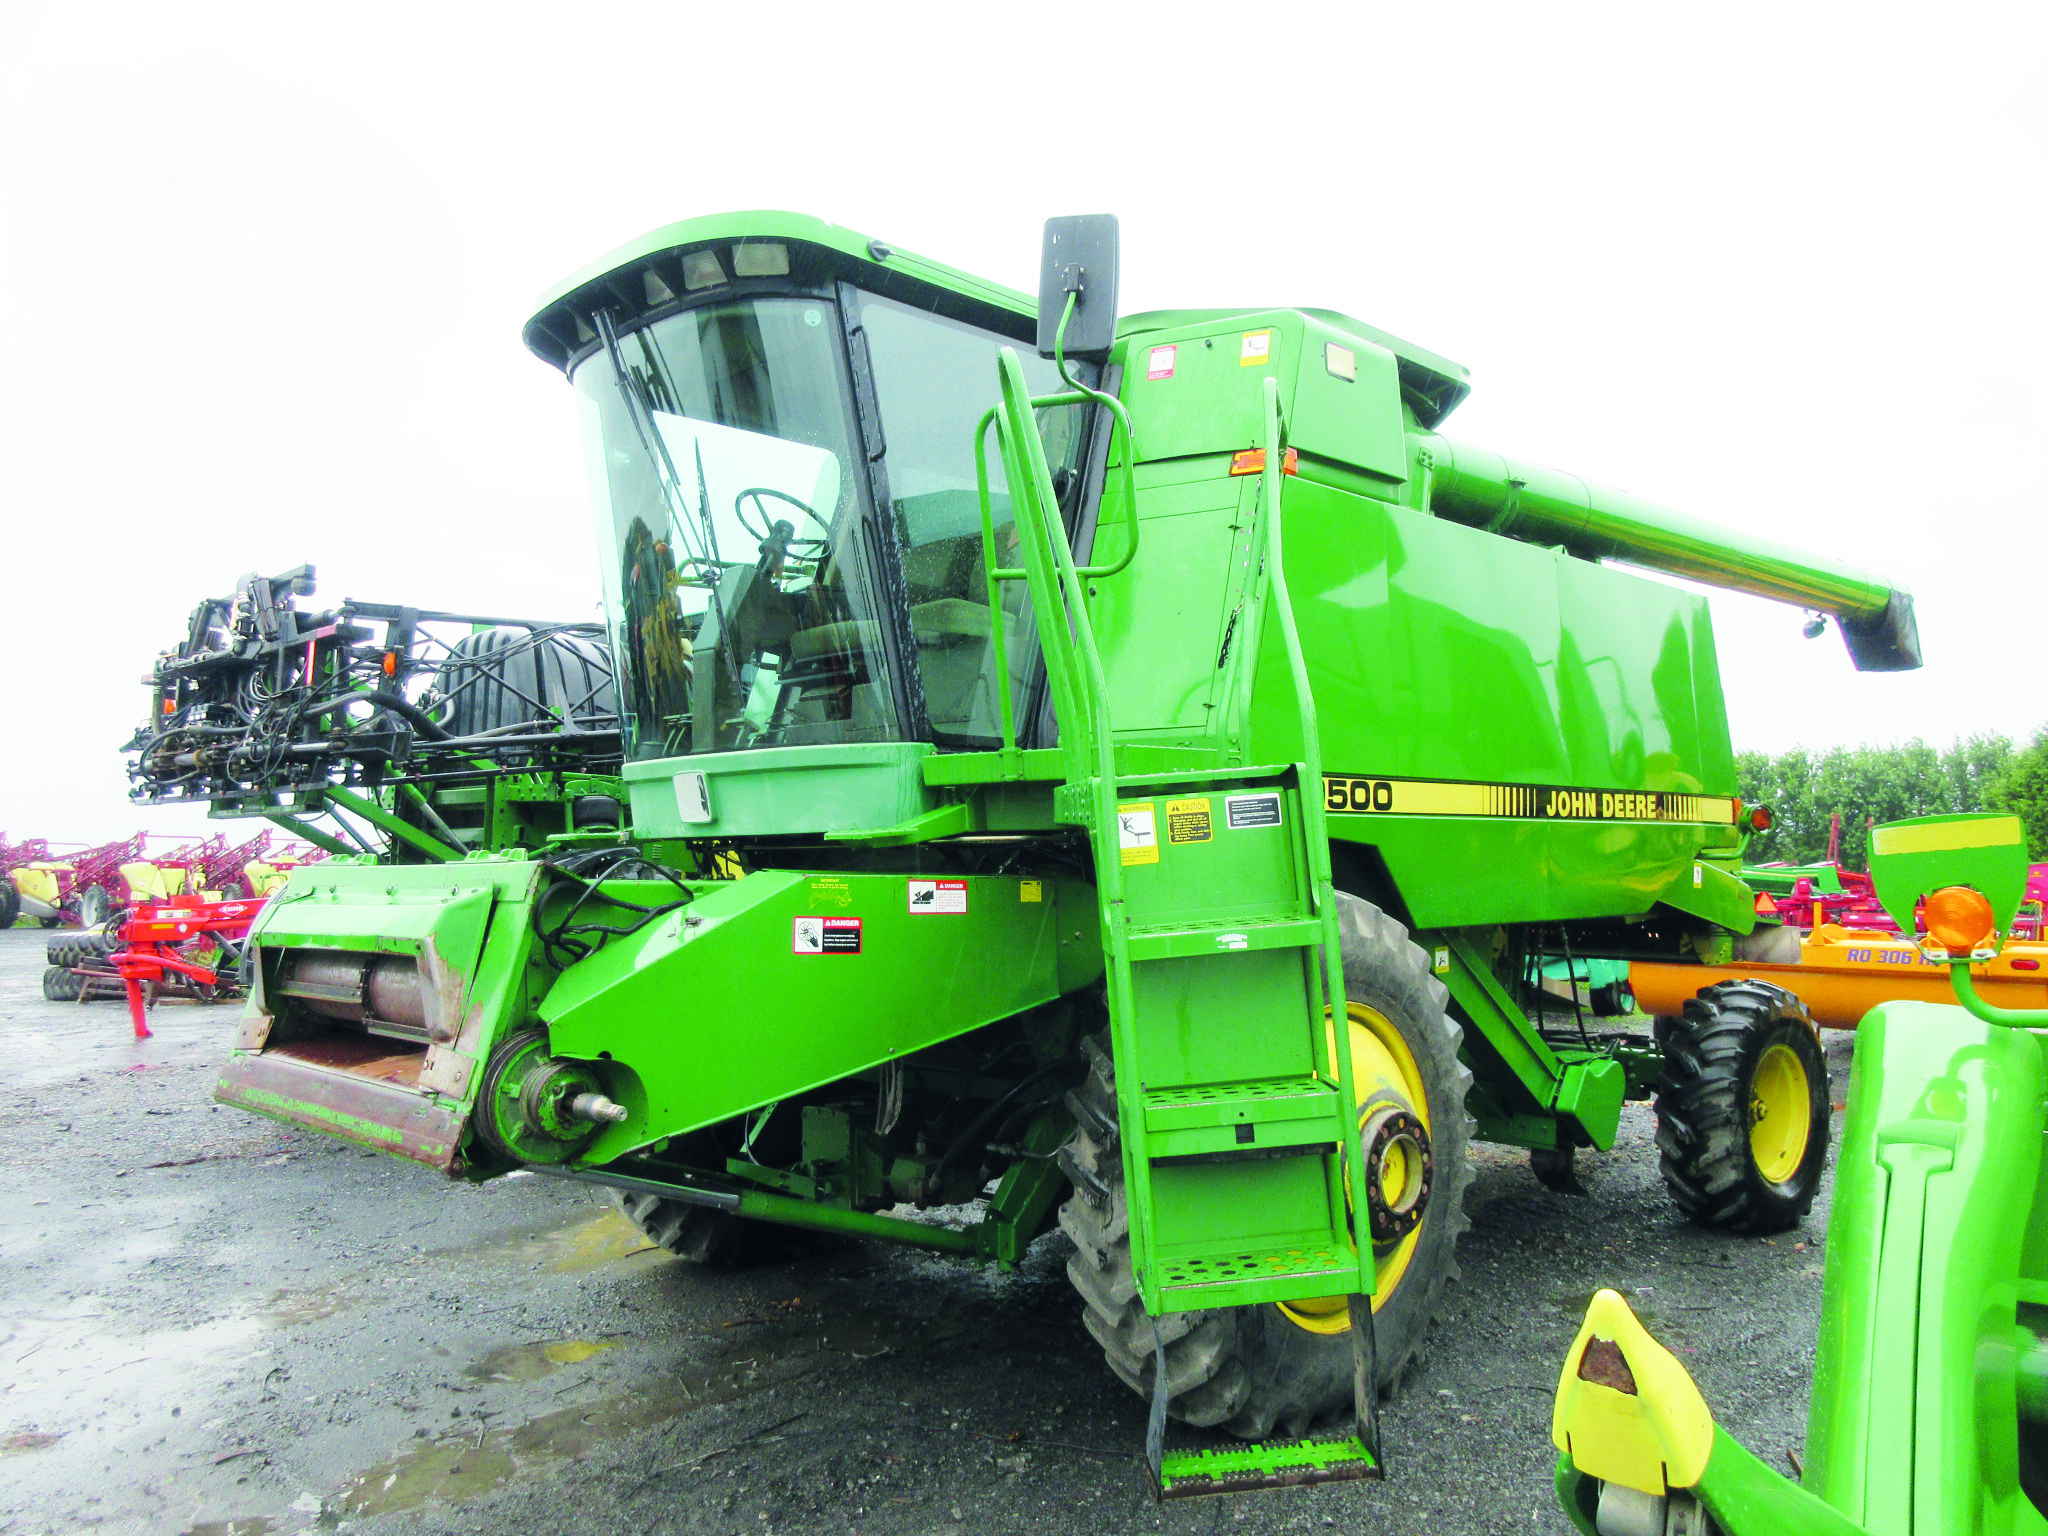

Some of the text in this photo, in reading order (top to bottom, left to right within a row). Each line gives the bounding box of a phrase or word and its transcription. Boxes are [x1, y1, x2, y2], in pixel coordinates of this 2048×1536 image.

[1322, 779, 1393, 810] 500
[1182, 803, 1206, 811] CAUTION
[1546, 790, 1657, 819] JOHN DEERE
[831, 919, 859, 927] DANGER
[1876, 950, 1912, 964] 306
